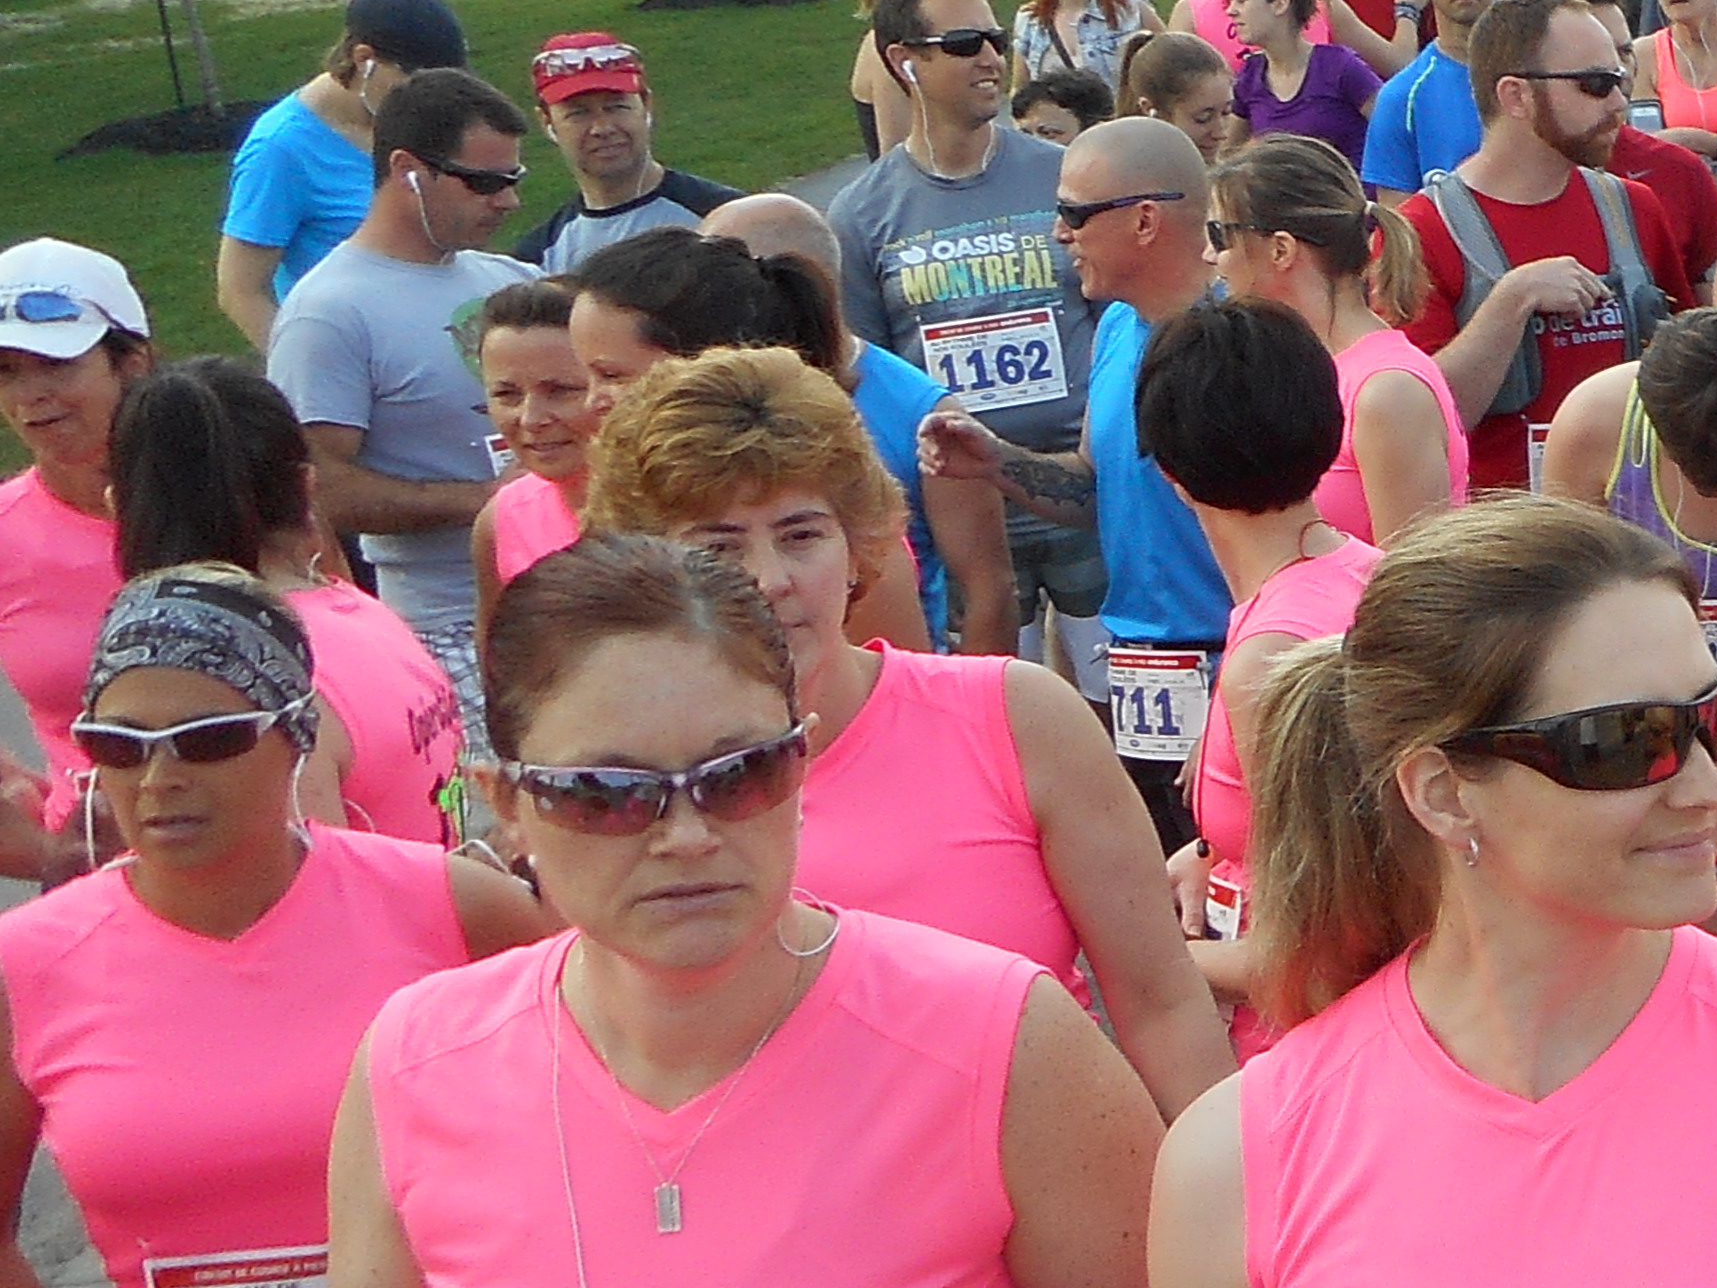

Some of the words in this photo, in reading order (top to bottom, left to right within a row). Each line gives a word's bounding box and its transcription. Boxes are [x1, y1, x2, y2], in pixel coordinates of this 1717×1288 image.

[932, 232, 1016, 260] OASIS
[1021, 235, 1048, 249] DE
[901, 249, 1058, 305] MONTREAL
[939, 339, 1053, 393] 1162
[1111, 685, 1181, 736] 711
